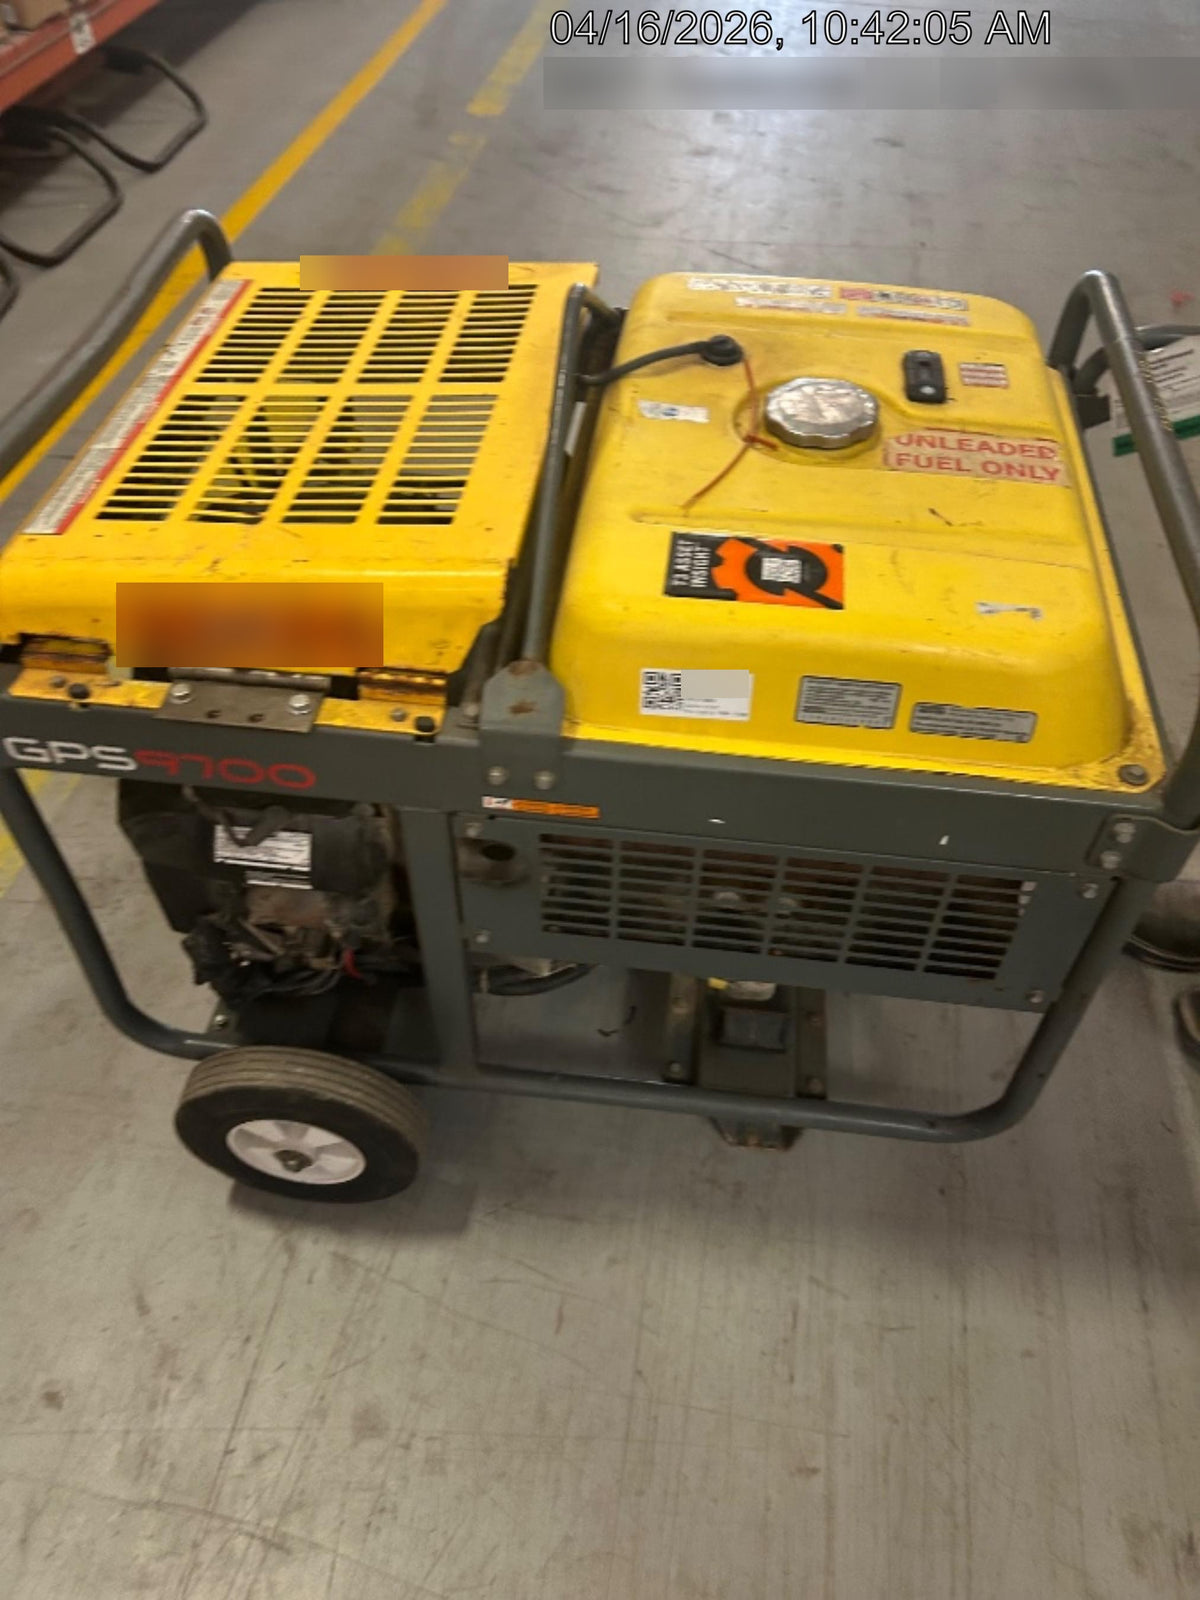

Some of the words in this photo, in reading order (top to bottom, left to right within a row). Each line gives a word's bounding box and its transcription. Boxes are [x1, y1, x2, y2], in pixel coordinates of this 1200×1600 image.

[894, 433, 1058, 460] UNLEADED
[896, 453, 971, 473] FUEL
[980, 460, 1060, 481] ONLY
[673, 539, 695, 572] ASSET
[690, 546, 712, 588] INSIGHT
